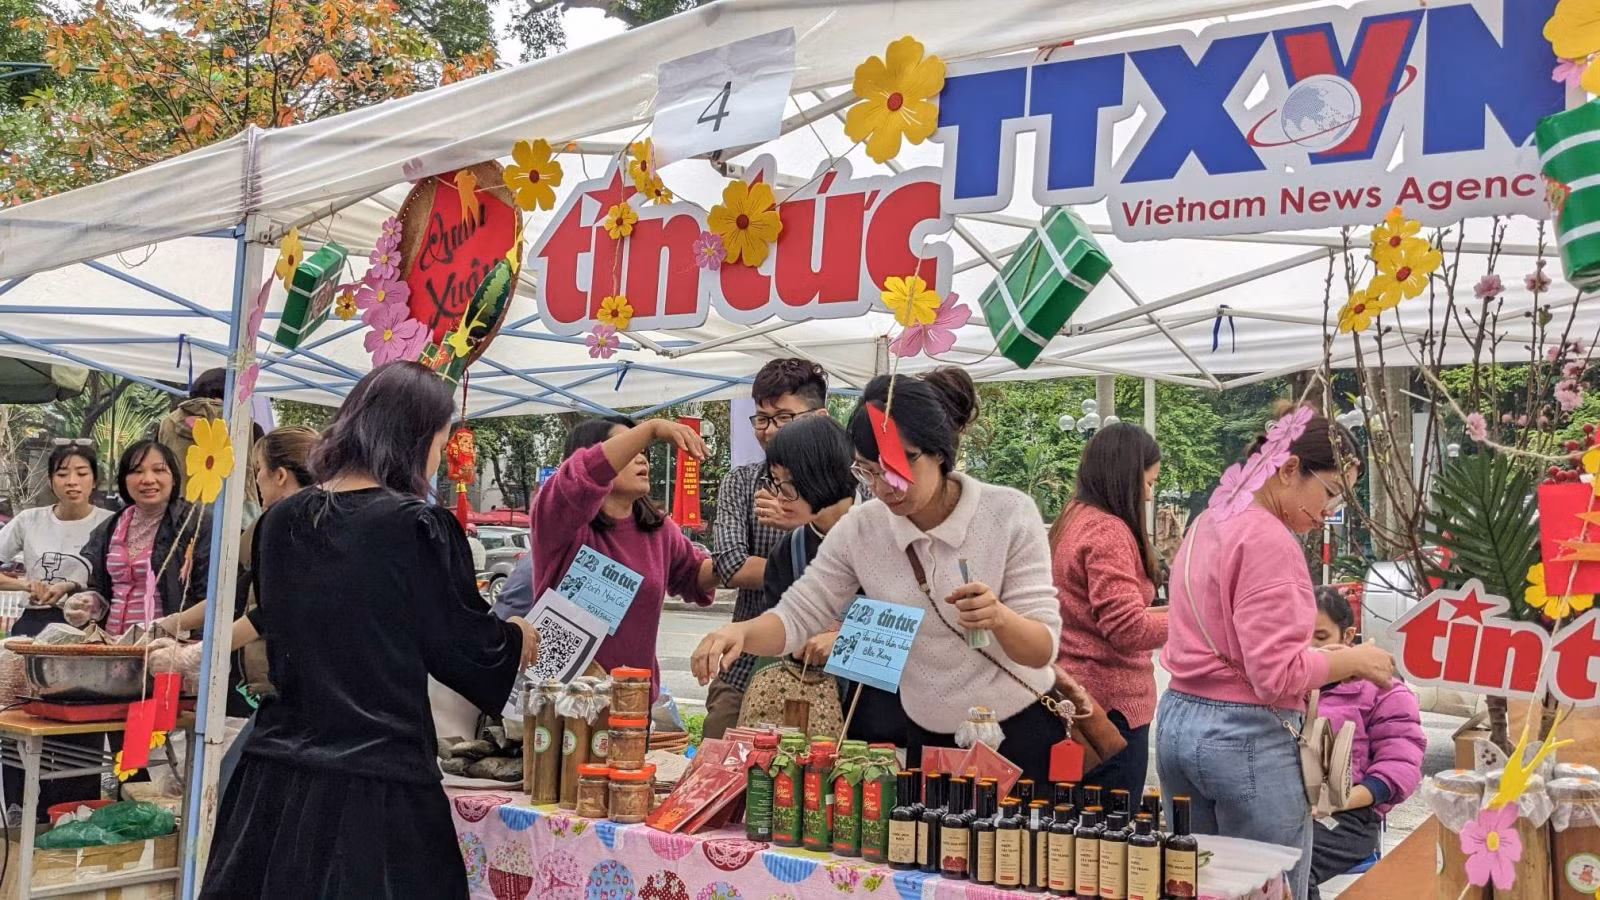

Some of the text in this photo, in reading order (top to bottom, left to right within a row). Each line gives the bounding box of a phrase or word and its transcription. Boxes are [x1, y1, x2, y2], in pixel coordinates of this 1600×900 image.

[698, 81, 731, 132] 4
[938, 0, 1566, 200] TTXVN
[1122, 172, 1548, 227] Vietnam News Agenc
[1396, 588, 1544, 693] tin
